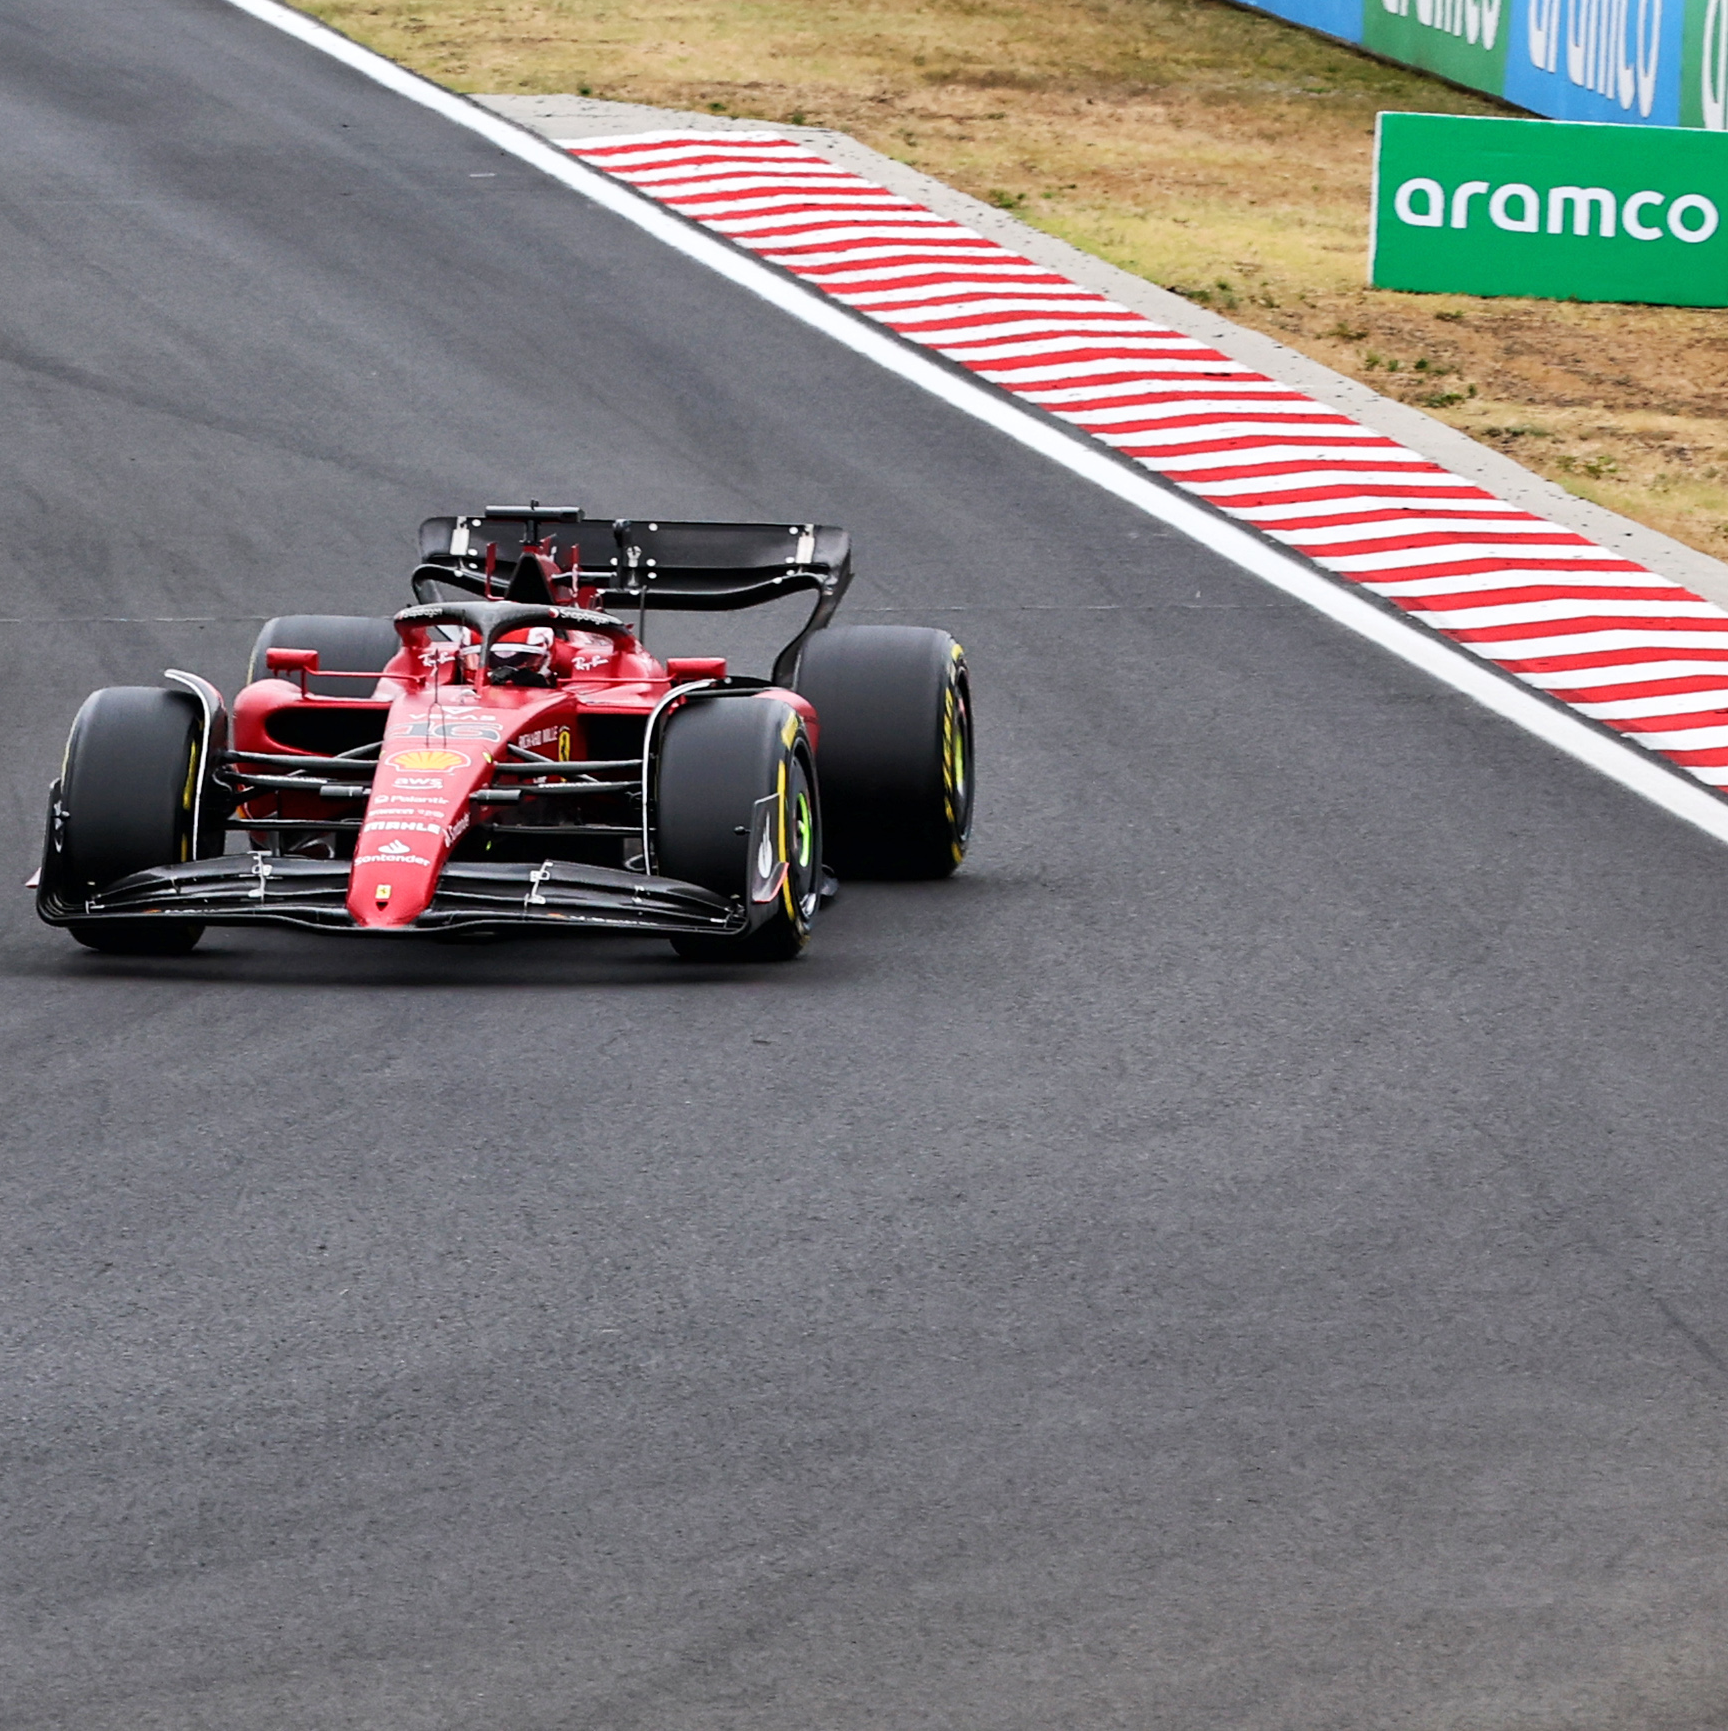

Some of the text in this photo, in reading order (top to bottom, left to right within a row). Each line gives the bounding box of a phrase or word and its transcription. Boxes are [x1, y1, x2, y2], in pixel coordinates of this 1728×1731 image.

[1395, 177, 1720, 244] aramco
[409, 713, 497, 721] VELAS
[387, 722, 504, 743] 16
[395, 777, 442, 785] aws
[363, 822, 442, 835] MAHLE
[354, 854, 431, 867] Santander
